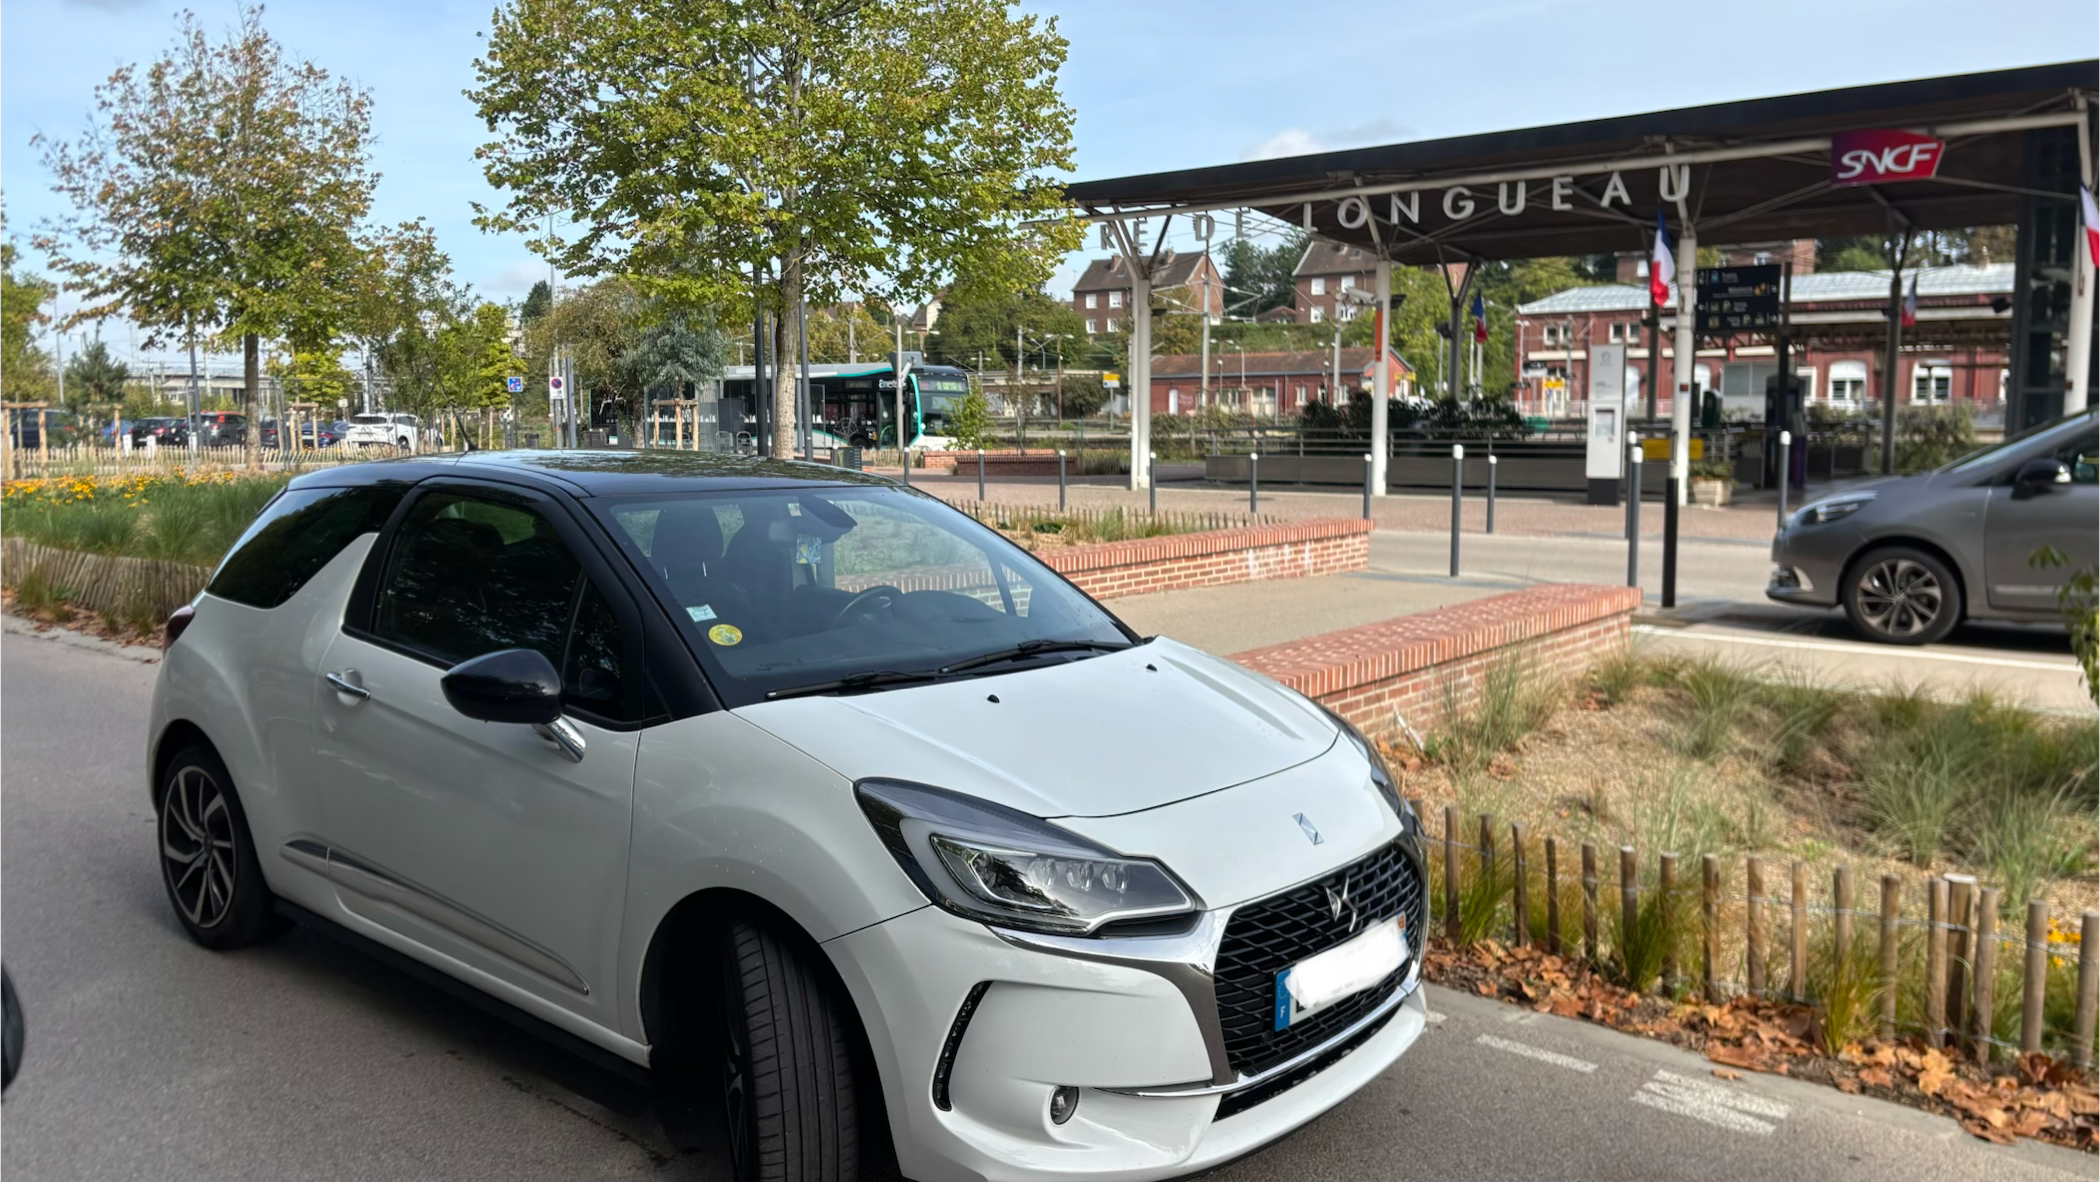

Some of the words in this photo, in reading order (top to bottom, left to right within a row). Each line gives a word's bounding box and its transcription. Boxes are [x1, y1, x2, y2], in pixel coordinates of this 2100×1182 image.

[1837, 142, 1939, 179] SNCF
[1192, 206, 1252, 242] DE
[1302, 164, 1691, 233] LONGUEAU
